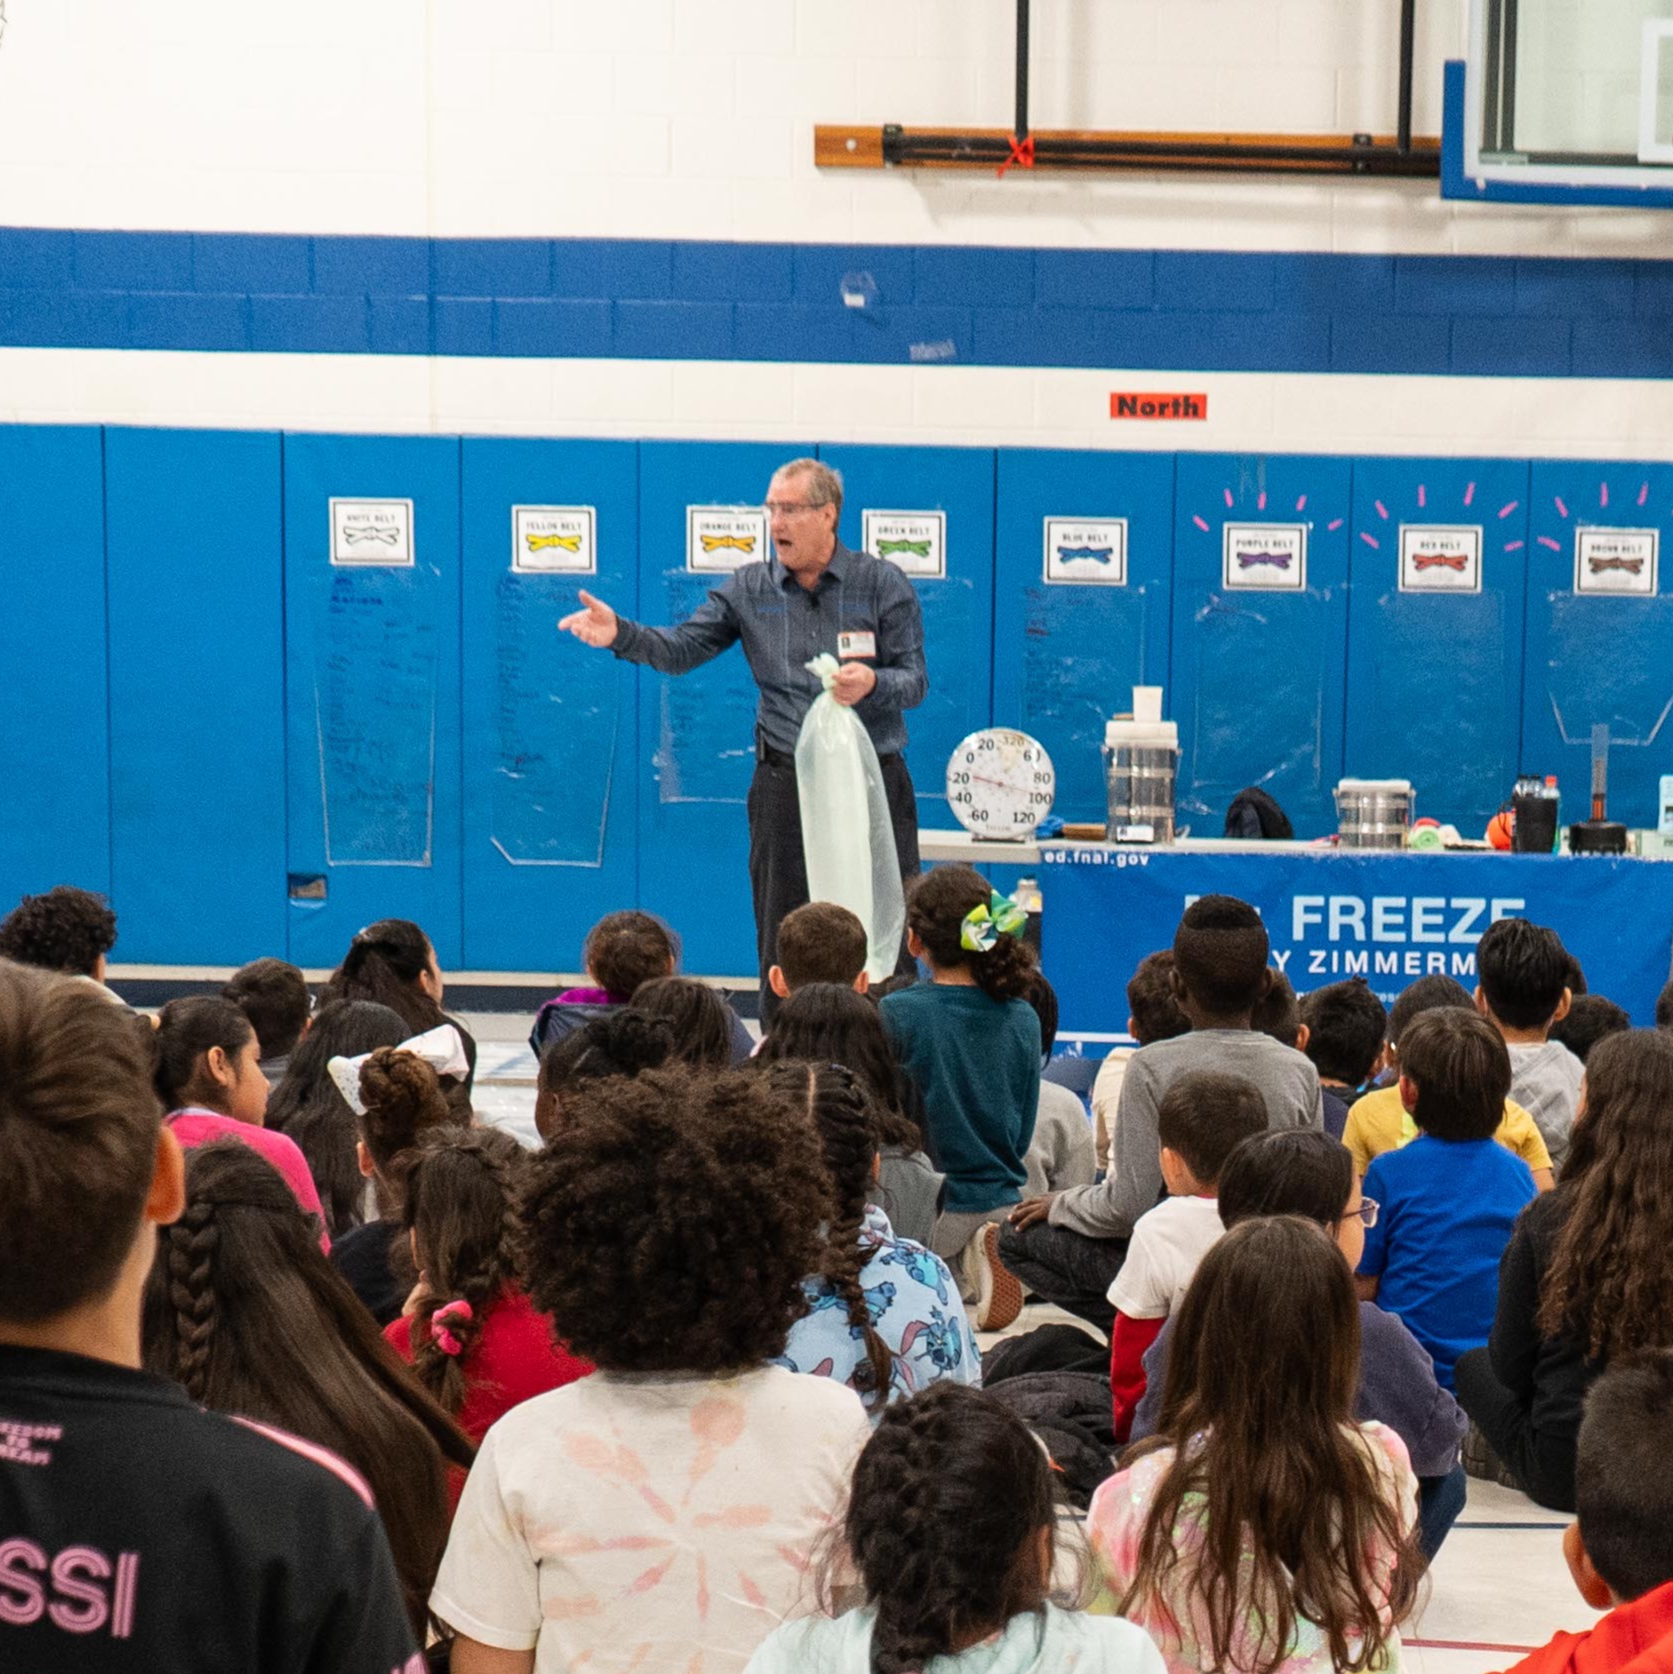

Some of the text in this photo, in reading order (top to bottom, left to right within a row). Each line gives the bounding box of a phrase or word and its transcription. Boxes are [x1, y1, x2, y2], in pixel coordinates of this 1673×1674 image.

[1116, 394, 1200, 419] North
[374, 514, 397, 524] BELT
[560, 521, 582, 531] BELT
[700, 522, 757, 532] ORANGE BELT
[909, 526, 930, 536] BELT
[1062, 533, 1108, 543] BLUE BELT
[1235, 539, 1294, 549] PURPLE BELT
[1420, 541, 1461, 551] RED BELT
[1621, 544, 1643, 554] BELT
[977, 737, 995, 750] 20
[966, 752, 975, 764] 0
[1033, 772, 1051, 784] 80
[1029, 792, 1052, 805] 100
[1012, 812, 1036, 824] 120
[1043, 850, 1150, 868] ed.fnal.gov
[1308, 951, 1476, 976] ZIMMERM
[6, 1434, 30, 1449] TO
